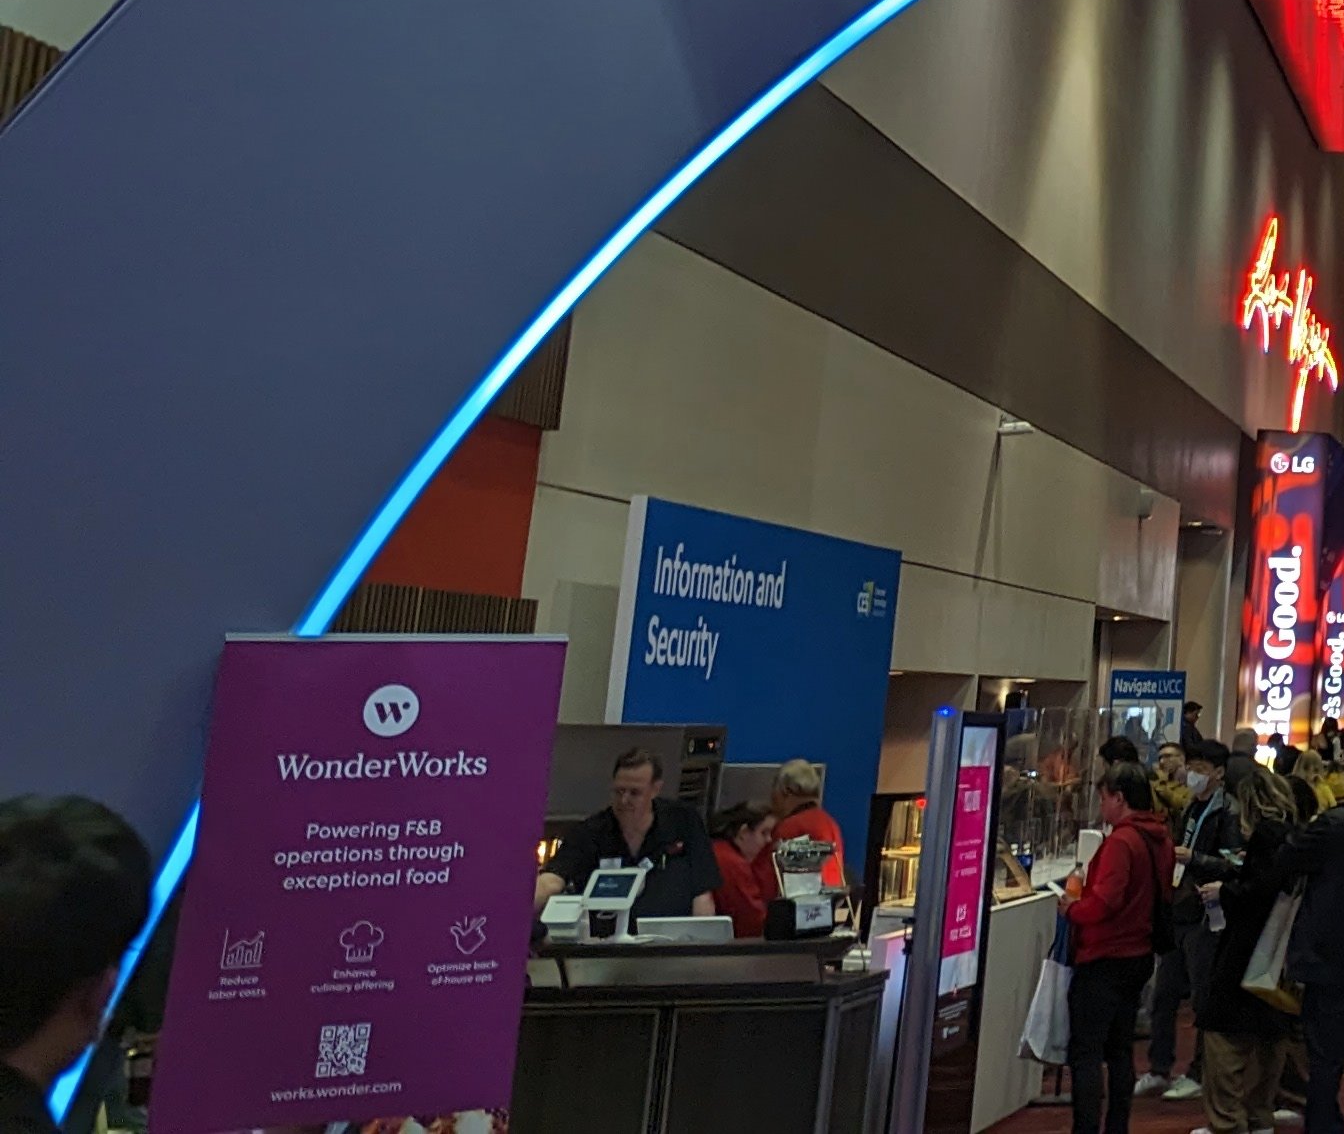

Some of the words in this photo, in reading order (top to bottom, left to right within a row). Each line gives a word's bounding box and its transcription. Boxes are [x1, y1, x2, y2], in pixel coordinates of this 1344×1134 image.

[1292, 456, 1315, 473] LG
[653, 542, 753, 605] Information
[755, 560, 787, 609] and
[1263, 545, 1303, 661] Good.
[645, 615, 720, 681] Security
[1113, 677, 1158, 697] Navigate
[1158, 678, 1183, 694] LVCC
[277, 750, 488, 781] WonderWorks
[306, 822, 400, 841] Powering
[405, 819, 442, 836] F&B
[274, 845, 384, 868] operations
[388, 841, 465, 862] through
[283, 869, 401, 891] exceptional
[406, 867, 451, 885] food
[332, 968, 377, 980] Enhance
[426, 961, 472, 974] Optimize
[219, 974, 259, 987] Reduce
[310, 981, 352, 995] culinary
[353, 979, 395, 993] offering
[208, 988, 238, 1001] labor
[238, 986, 267, 999] costs
[271, 1081, 402, 1103] works.wonder.com
